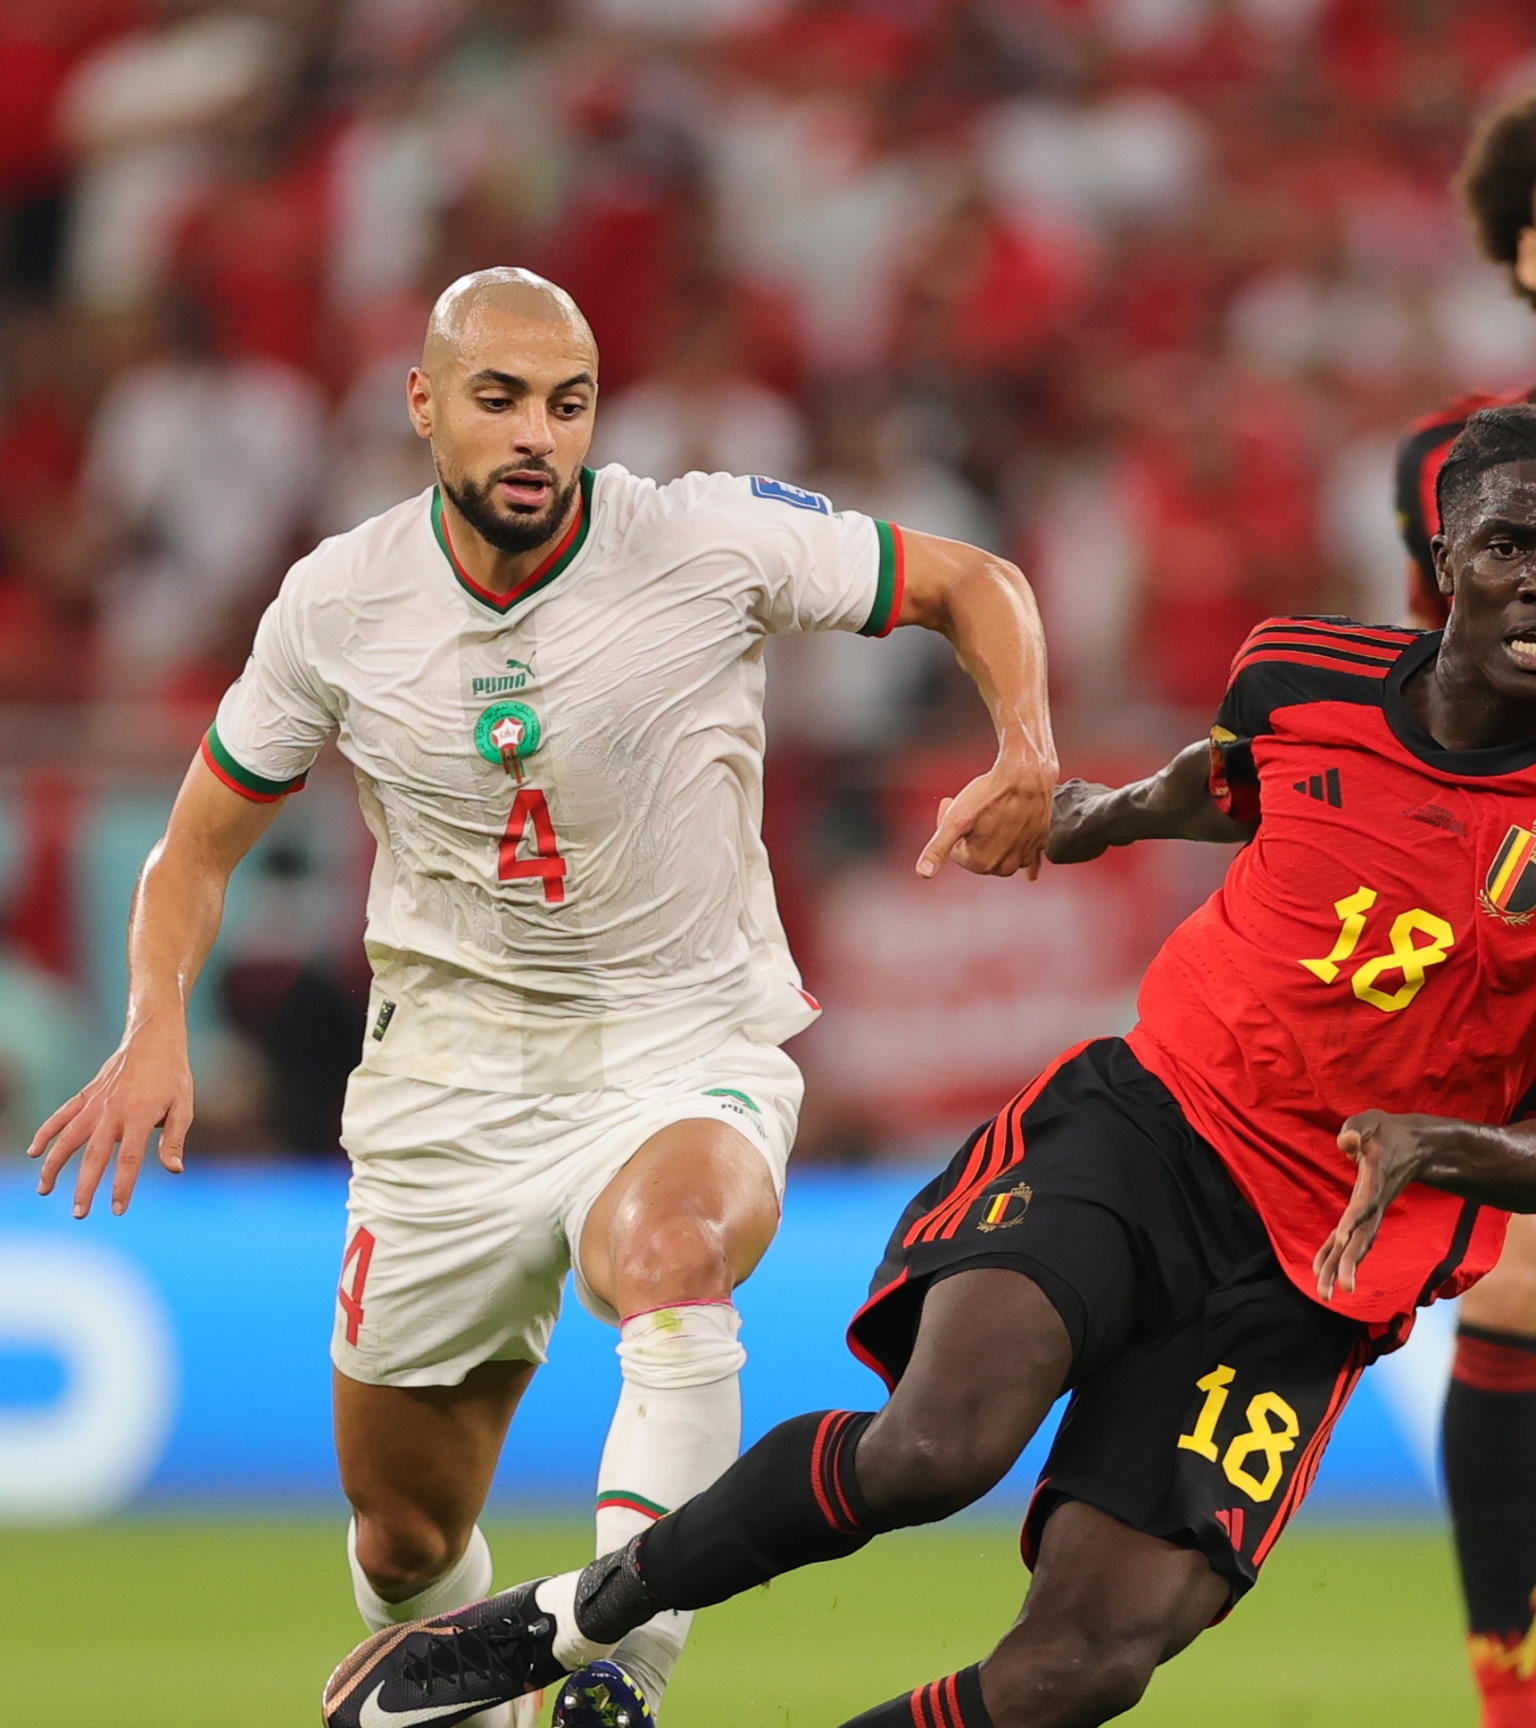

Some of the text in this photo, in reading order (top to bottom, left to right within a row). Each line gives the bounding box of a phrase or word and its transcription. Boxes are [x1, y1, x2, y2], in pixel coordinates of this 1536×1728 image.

[472, 672, 526, 695] PUMA
[498, 789, 567, 903] 4
[1297, 885, 1455, 1013] 18
[338, 1225, 376, 1348] 4
[1177, 1364, 1300, 1503] 18
